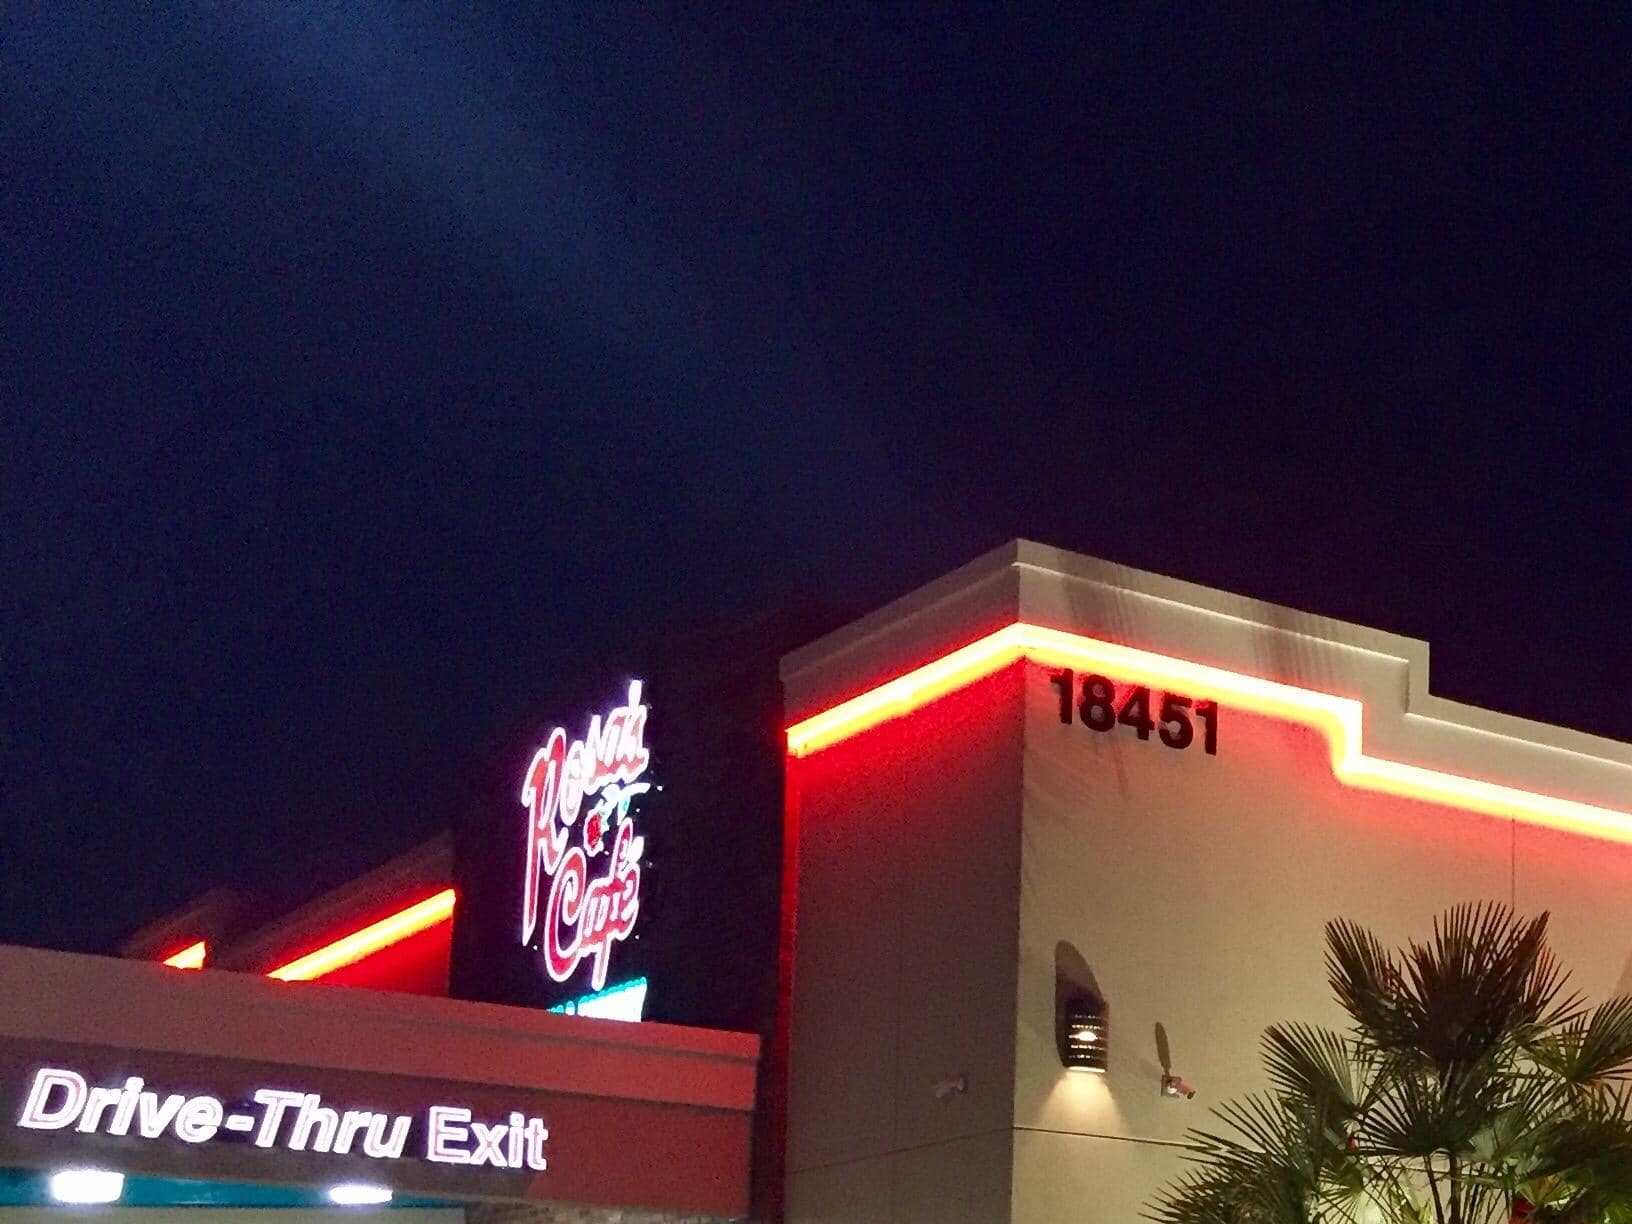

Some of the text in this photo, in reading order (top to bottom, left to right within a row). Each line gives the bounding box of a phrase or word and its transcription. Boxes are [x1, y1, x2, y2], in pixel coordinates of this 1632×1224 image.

[1050, 668, 1217, 756] 18451
[17, 1068, 549, 1171] Drive-Thru Exit
